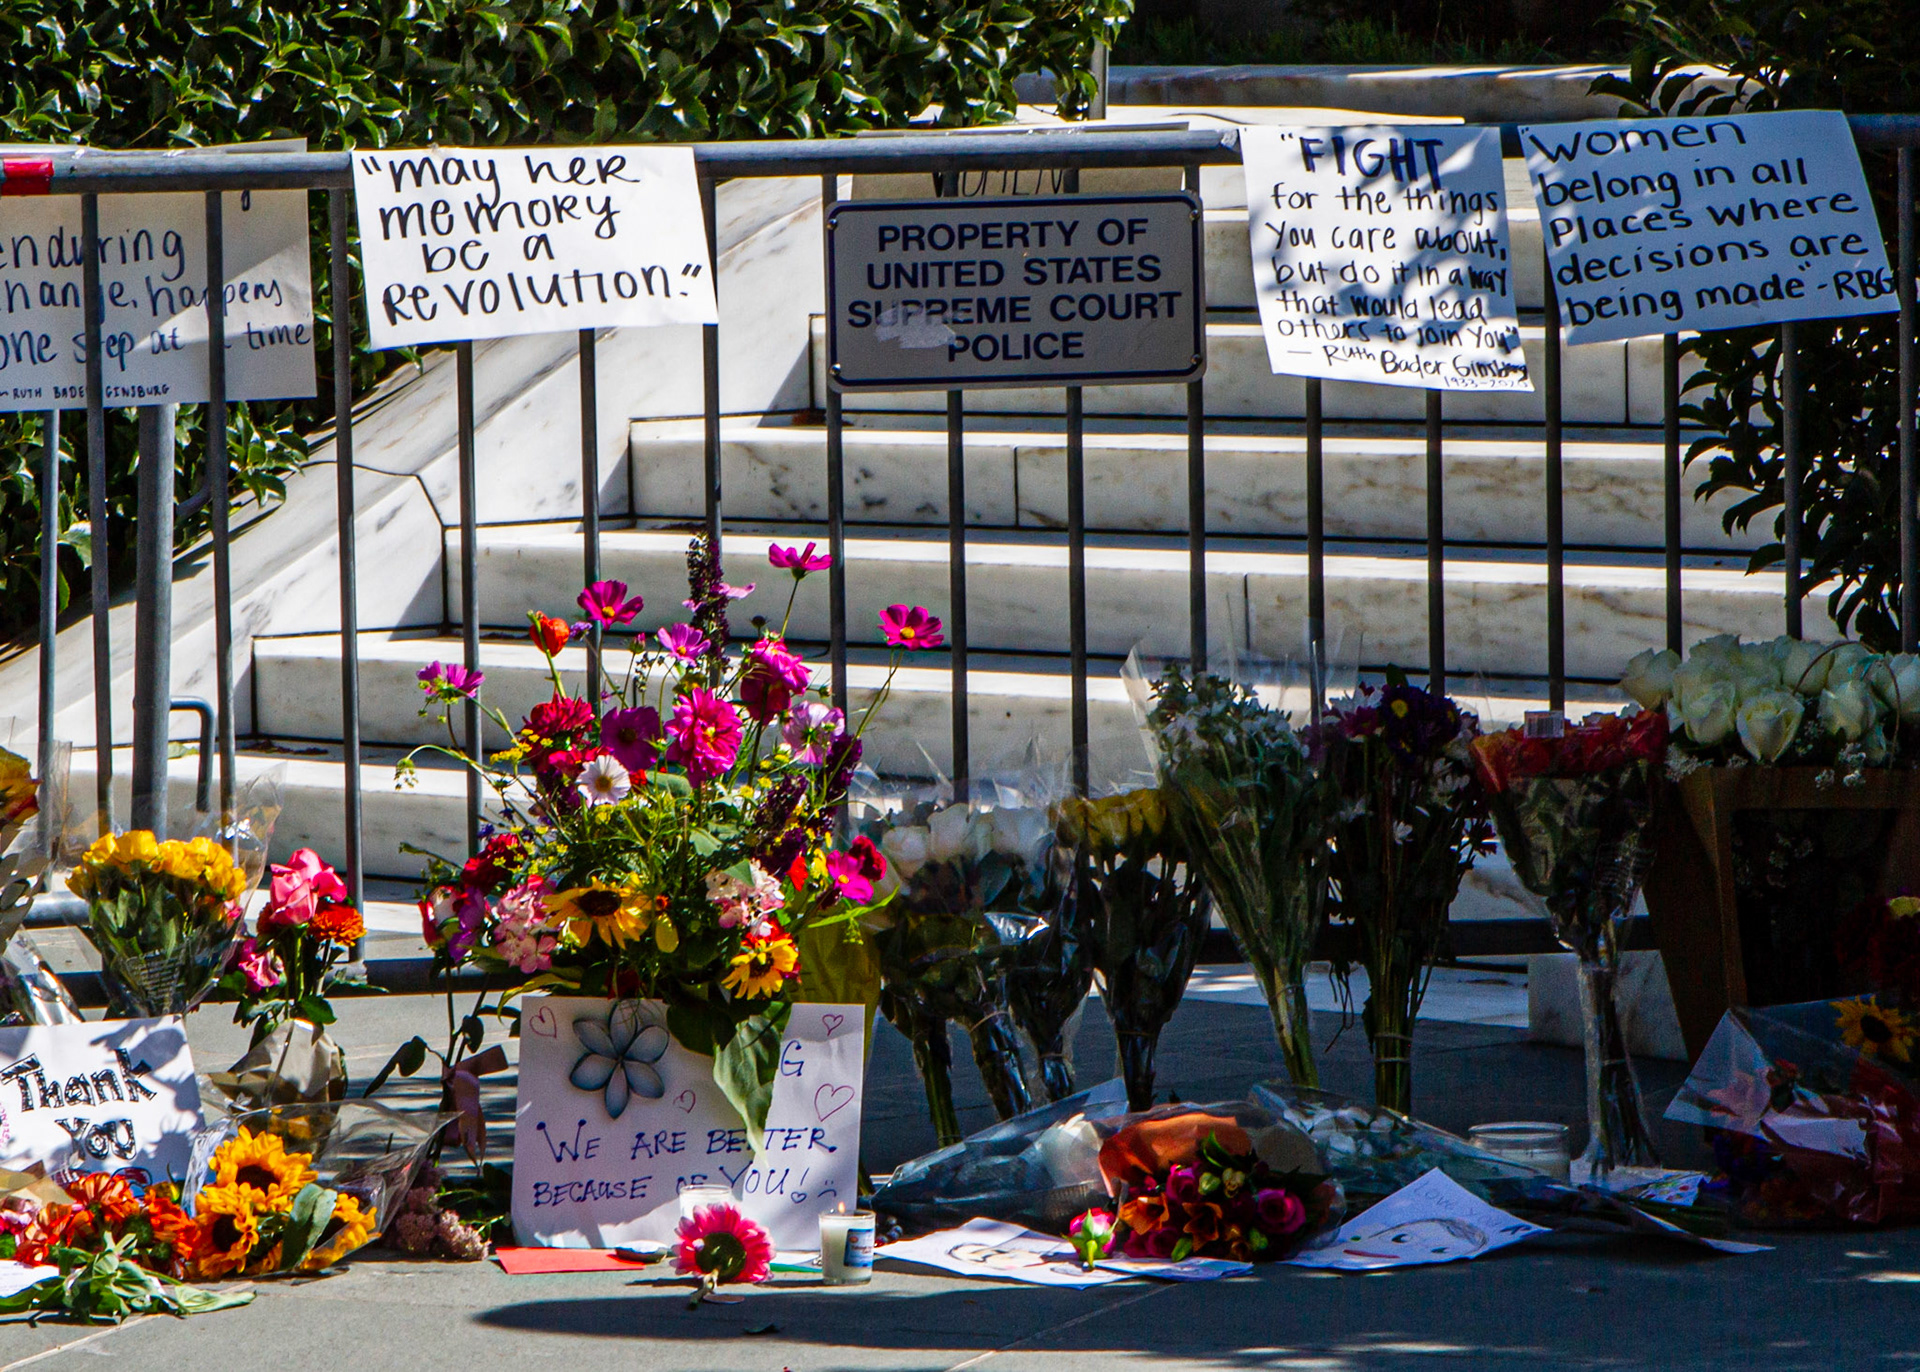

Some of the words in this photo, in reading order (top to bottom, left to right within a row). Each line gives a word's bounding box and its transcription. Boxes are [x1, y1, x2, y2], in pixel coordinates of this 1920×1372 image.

[1538, 170, 1682, 208] belong
[1694, 158, 1736, 188] in
[1752, 157, 1808, 186] all
[1271, 182, 1319, 210] for
[1335, 186, 1391, 215] the
[1403, 187, 1499, 226] things
[421, 238, 489, 274] be
[522, 233, 555, 261] a
[878, 220, 1079, 252] PROPERTY
[1096, 218, 1149, 246] OF
[1331, 225, 1397, 253] care
[866, 259, 1005, 290] UNITED
[1023, 254, 1162, 284] STATES
[1271, 256, 1329, 285] but
[1339, 260, 1380, 284] do
[1391, 260, 1410, 286] it
[1417, 262, 1440, 287] in
[1448, 267, 1465, 287] a
[1467, 266, 1507, 296] way
[1556, 239, 1769, 286] decisions
[1789, 232, 1869, 257] are
[847, 297, 1032, 329] SUPREME
[1049, 291, 1183, 322] COURT
[1276, 290, 1340, 315] that
[1350, 294, 1418, 320] would
[1430, 296, 1488, 326] lead
[1566, 286, 1683, 327] being
[72, 330, 135, 372] sep
[150, 326, 185, 355] at
[243, 321, 312, 350] time
[948, 331, 1085, 363] POLICE
[1382, 324, 1408, 342] to
[1322, 343, 1376, 367] Ruth
[1380, 349, 1448, 379] Bader
[53, 386, 86, 399] BADE
[105, 383, 171, 398] GINSBURG
[537, 1119, 602, 1163] WE
[631, 1131, 688, 1161] ARE
[706, 1127, 838, 1155] BETER
[533, 1175, 653, 1208] BECAUSE
